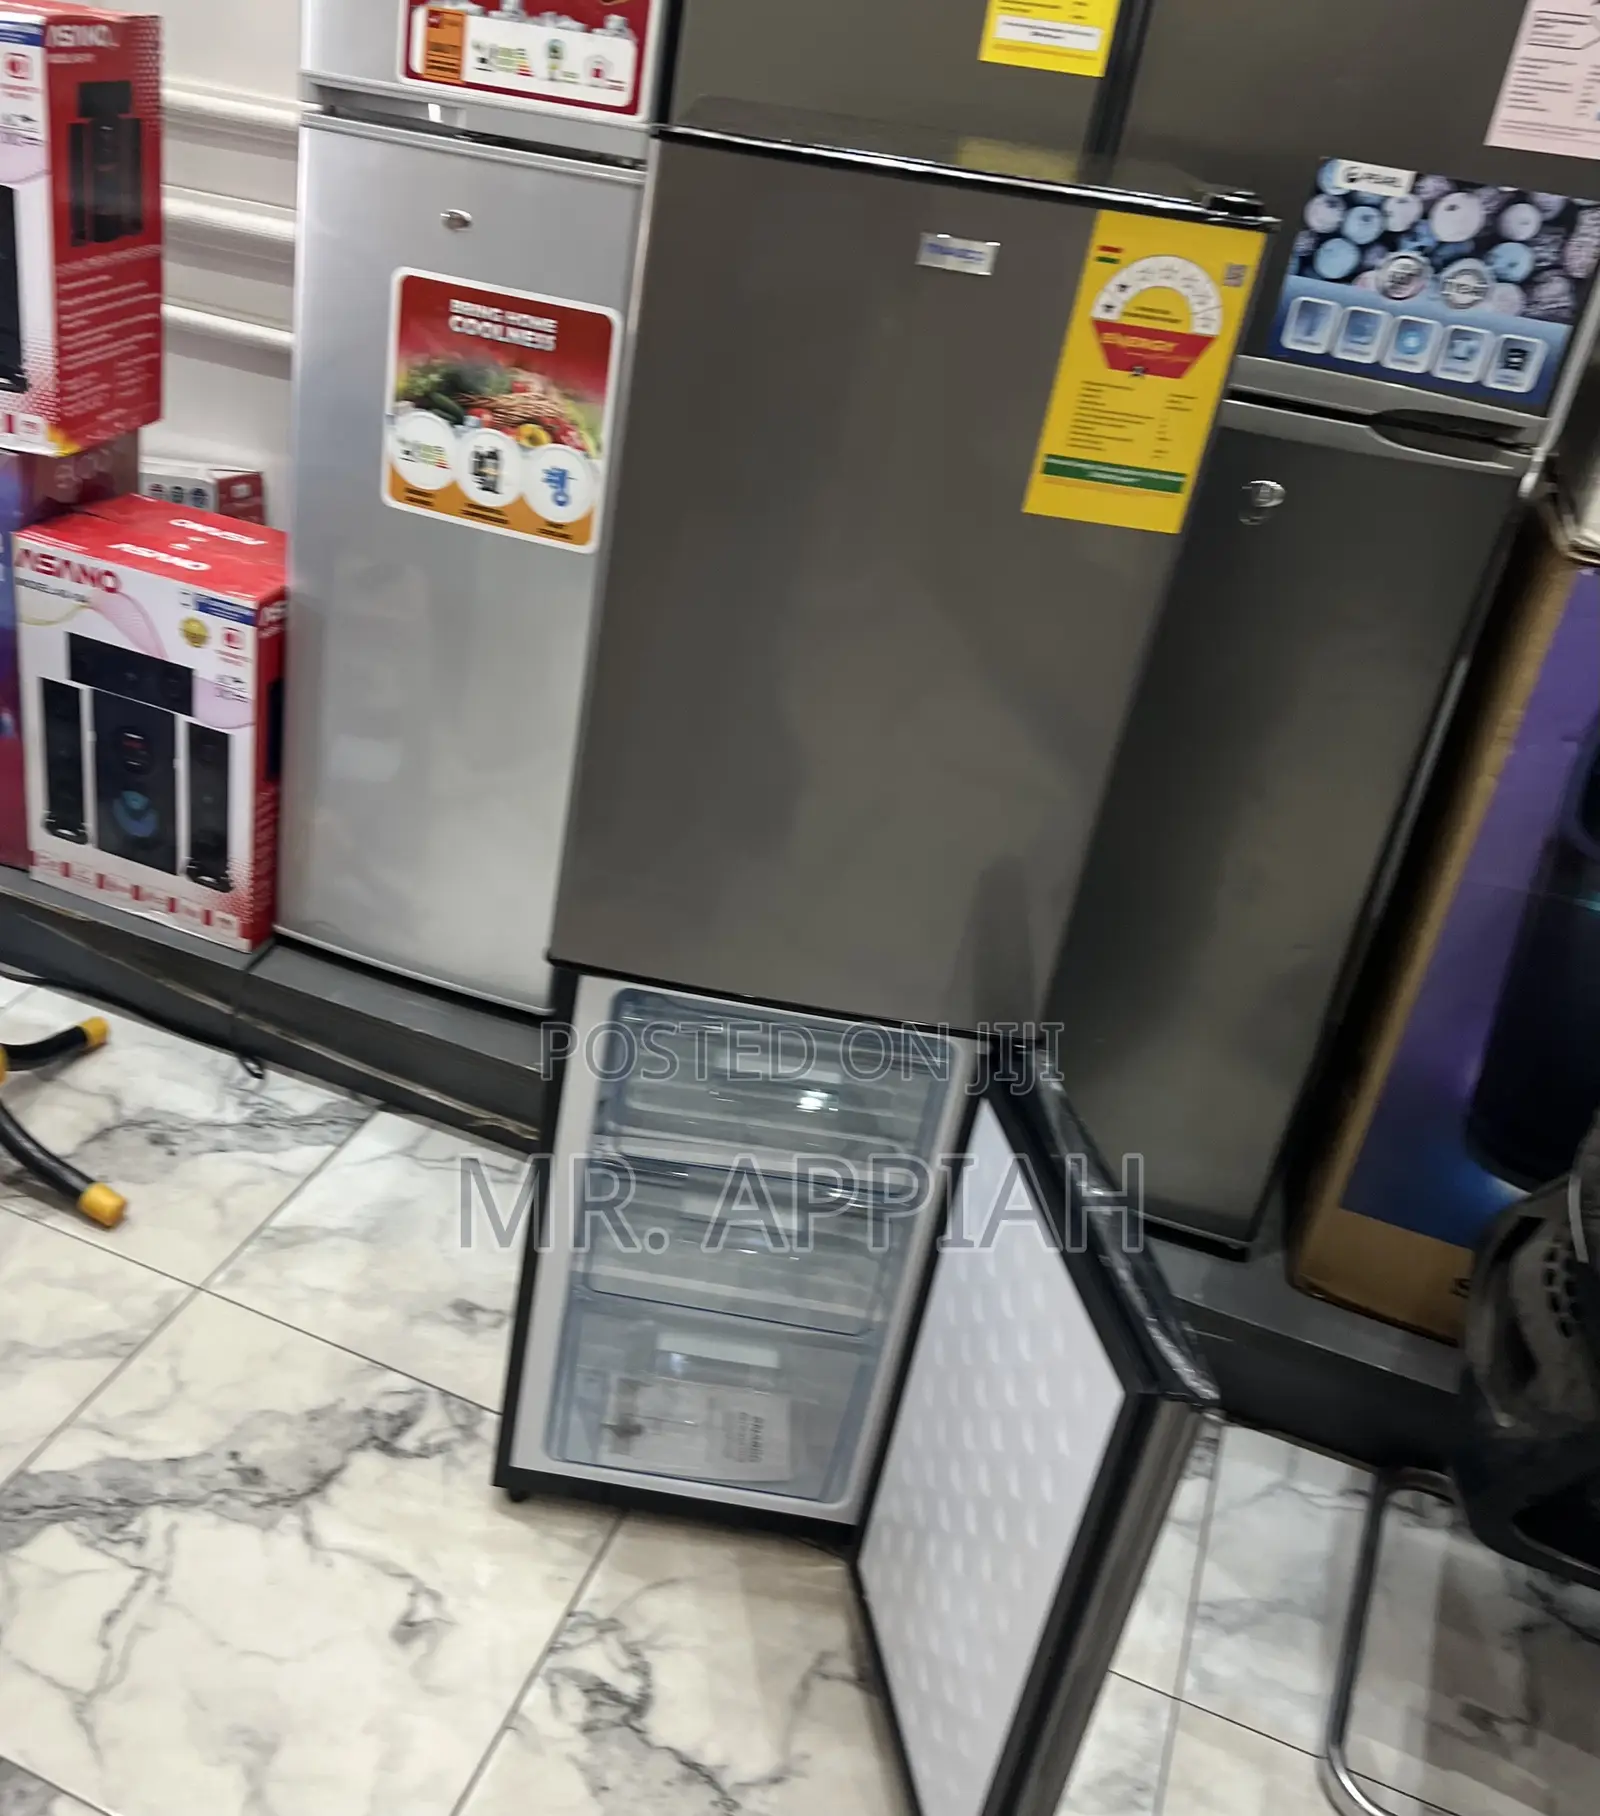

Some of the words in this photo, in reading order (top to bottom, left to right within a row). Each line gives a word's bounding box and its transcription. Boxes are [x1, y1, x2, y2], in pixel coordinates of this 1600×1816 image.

[448, 314, 557, 352] COOLNESS
[449, 298, 505, 321] BRING
[504, 310, 559, 335] HOME
[15, 547, 123, 595] ASANO
